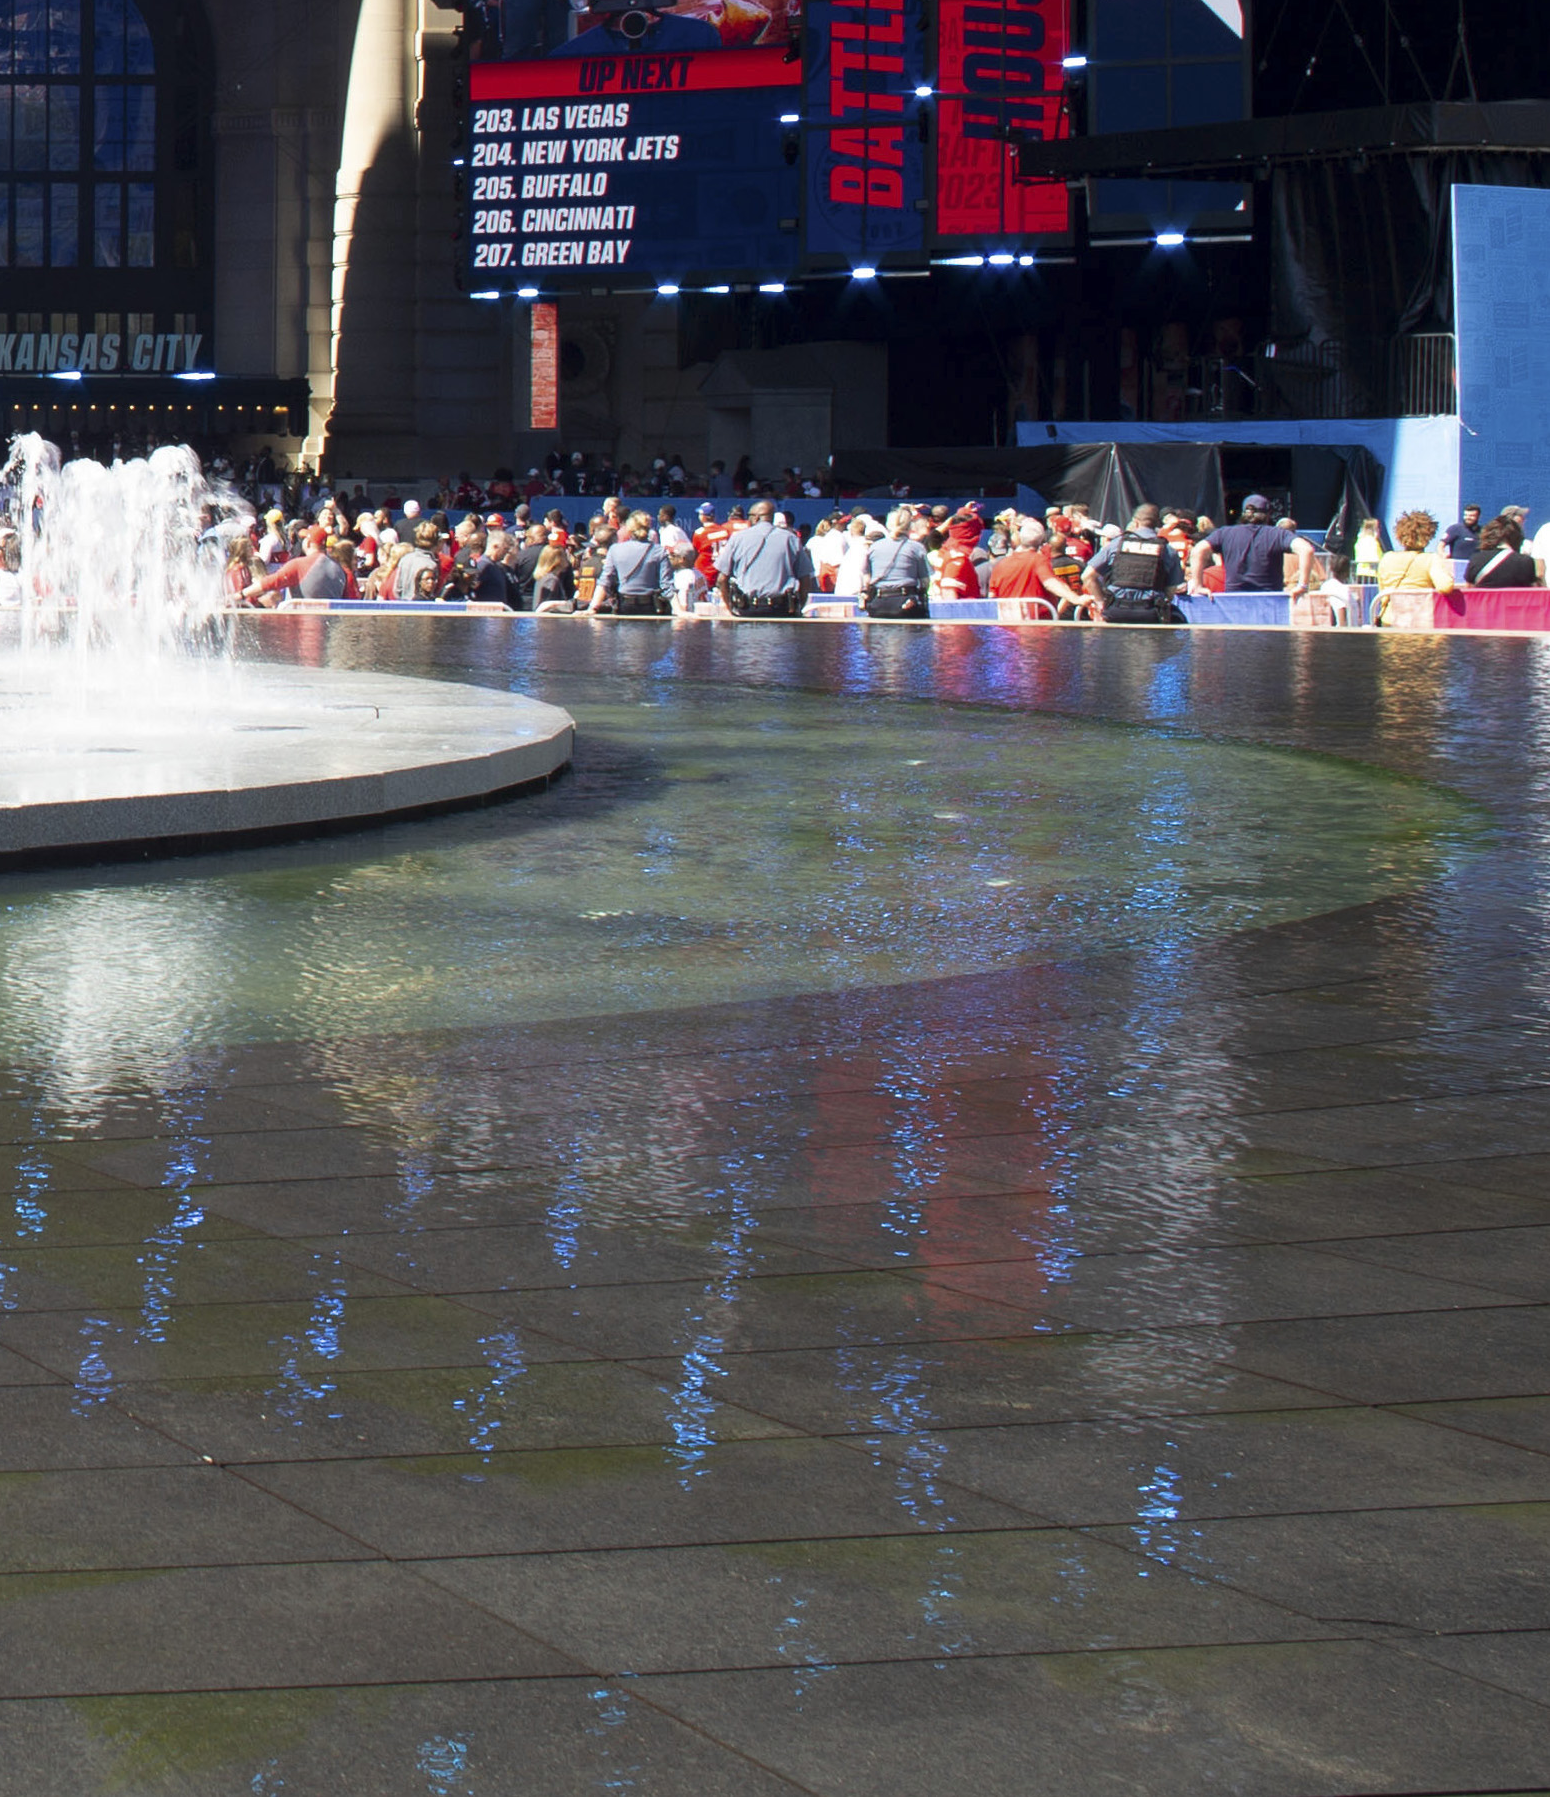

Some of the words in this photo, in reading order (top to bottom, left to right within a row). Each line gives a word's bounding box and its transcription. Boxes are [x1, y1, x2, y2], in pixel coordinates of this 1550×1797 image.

[579, 59, 616, 92] UP
[622, 56, 694, 90] NEXT
[473, 108, 517, 133] 203.
[521, 106, 559, 131] LAS
[565, 103, 630, 129] VEGAS
[472, 142, 518, 167] 204.
[521, 139, 568, 165] NEW
[572, 137, 626, 163] YORK
[628, 135, 680, 161] JETS
[473, 175, 518, 201] 205.
[522, 173, 609, 199] BUFFALO
[472, 209, 518, 234] 206.
[522, 206, 637, 232] CINCINNATI
[473, 242, 518, 268] 207.
[522, 240, 581, 266] GREEN
[587, 239, 633, 265] BAY
[131, 333, 203, 371] CITY
